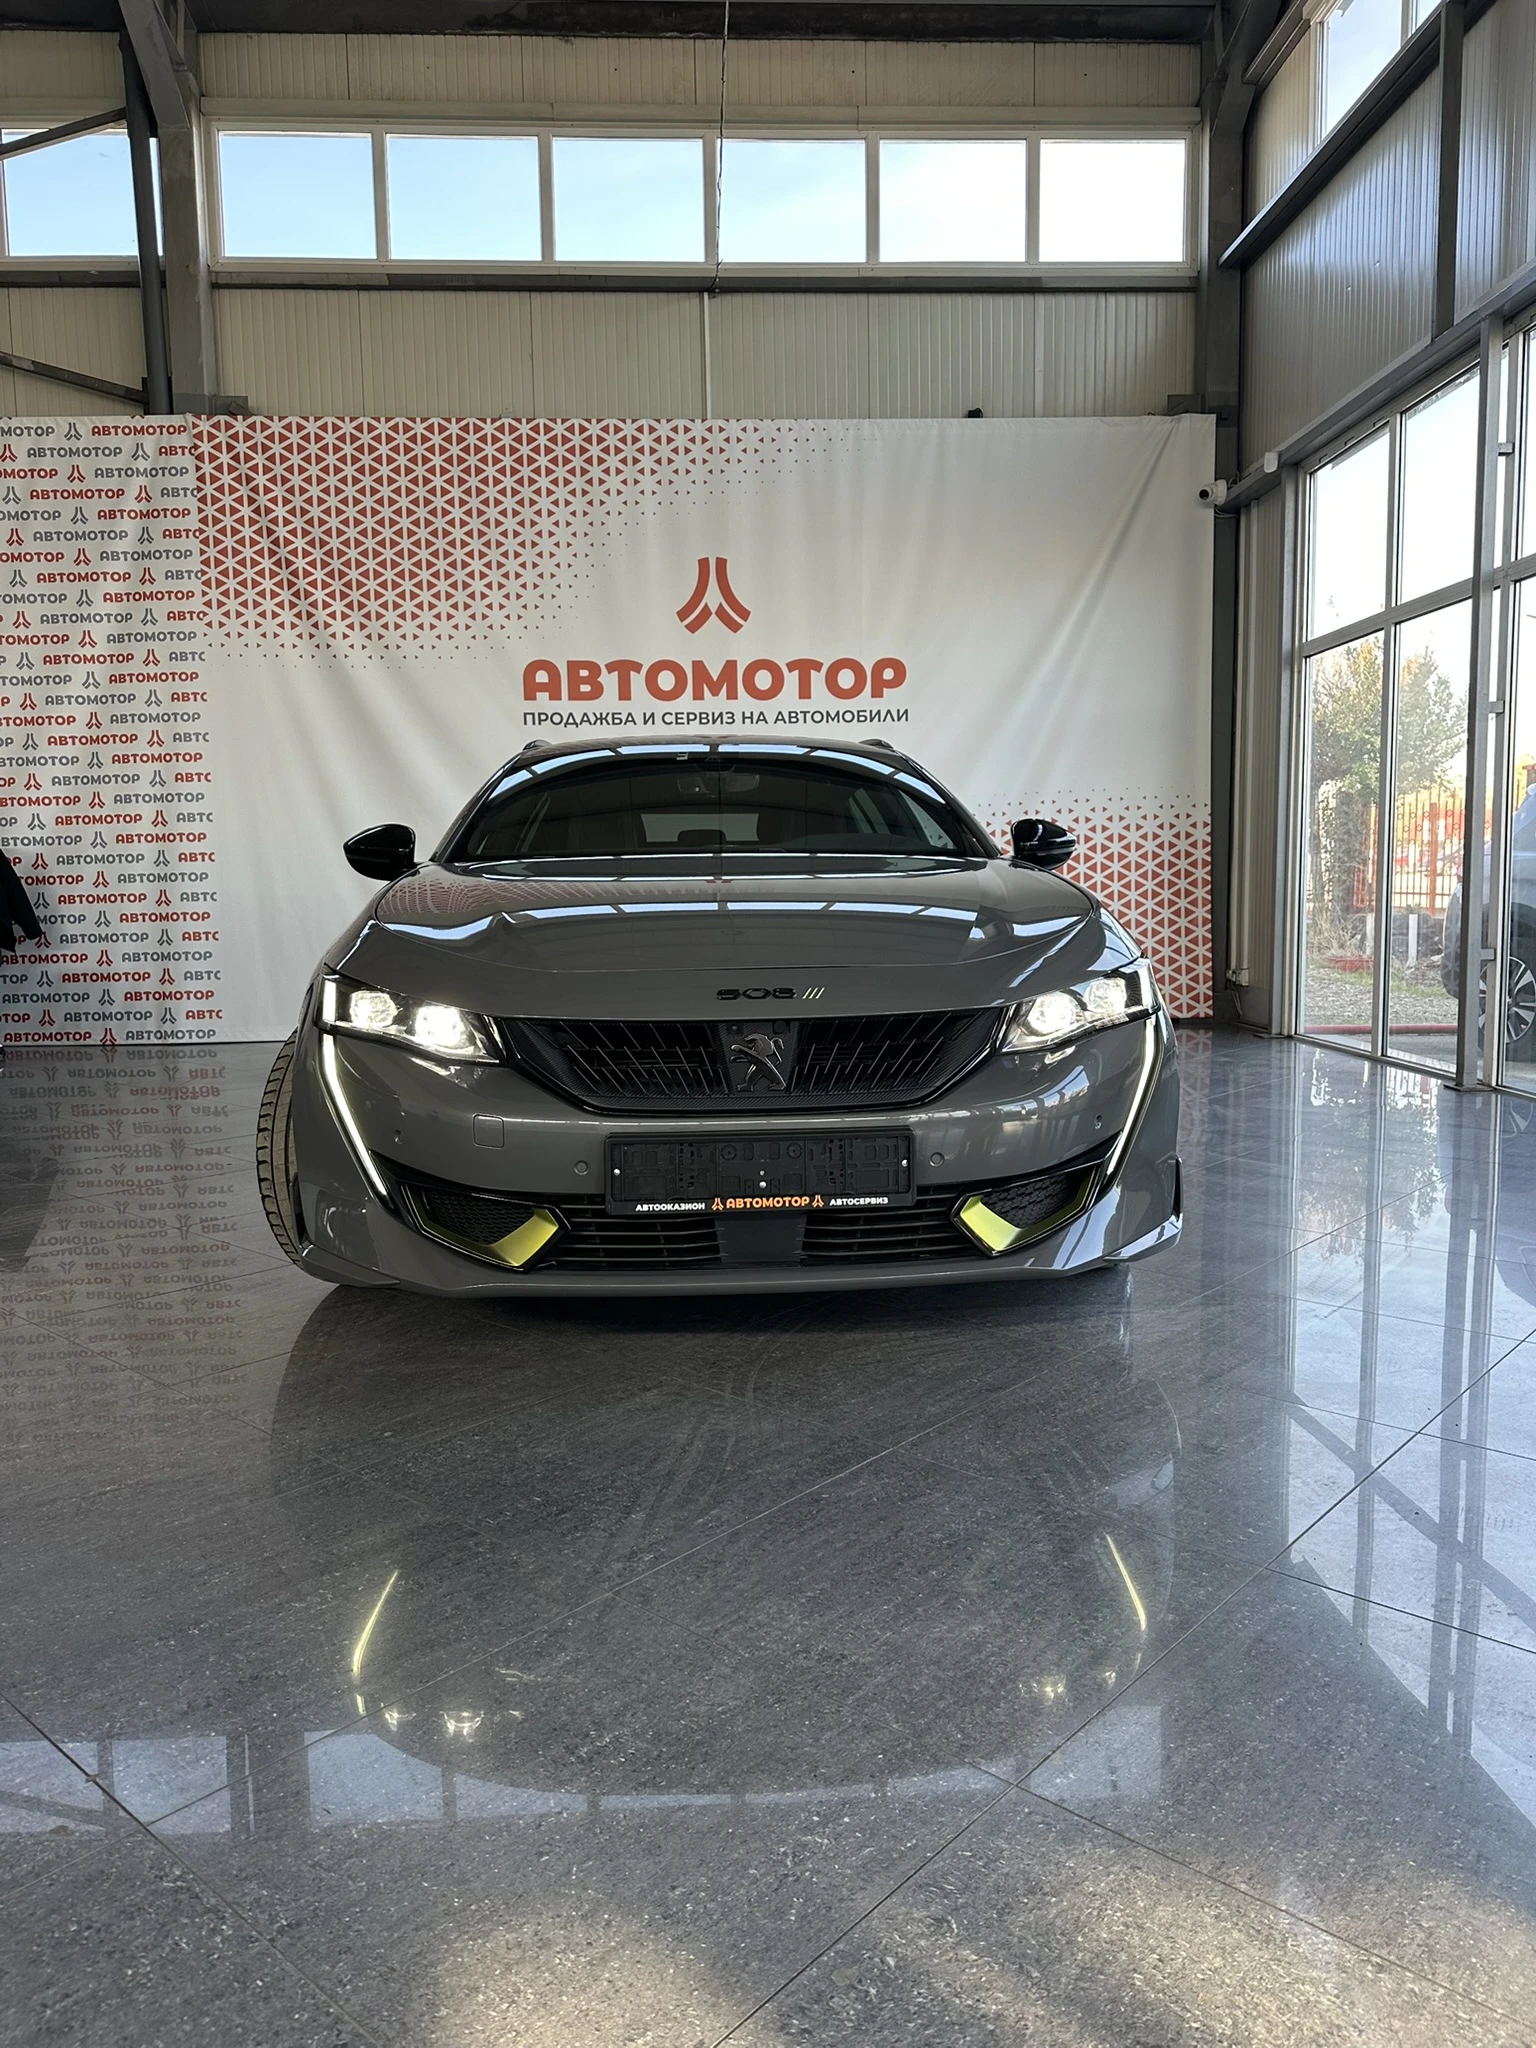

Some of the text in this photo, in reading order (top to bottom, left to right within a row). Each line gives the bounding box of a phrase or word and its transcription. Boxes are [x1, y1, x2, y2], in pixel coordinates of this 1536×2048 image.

[92, 424, 187, 436] АВТОМОТОР
[27, 447, 122, 458] АВТОМОТОР
[95, 467, 189, 478] АВТОМОТОР
[30, 488, 125, 500] АВТОМОТОР
[98, 508, 191, 520] АВТОМОТОР
[34, 530, 128, 541] АВТОМОТОР
[100, 549, 193, 561] АВТОМОТОР
[37, 571, 131, 583] АВТОМОТОР
[103, 590, 195, 602] АВТОМОТОР
[40, 613, 132, 624] АВТОМОТОР
[107, 631, 197, 644] АВТОМОТОР
[43, 653, 134, 665] АВТОМОТОР
[109, 672, 199, 684] АВТОМОТОР
[523, 657, 907, 701] АВТОМОТОР
[46, 694, 136, 705] АВТОМОТОР
[110, 712, 200, 724] АВТОМОТОР
[523, 708, 909, 728] ПРОДАЖБА И СЕРВИЗ НА АВТОМОБИЛИ
[48, 734, 138, 746] АВТОМОТОР
[112, 752, 202, 764] АВТОМОТОР
[52, 774, 140, 786] АВТОМОТОР
[114, 793, 204, 804] АВТОМОТОР
[55, 814, 142, 826] АВТОМОТОР
[116, 832, 206, 844] АВТОМОТОР
[57, 854, 144, 865] АВТОМОТОР
[118, 872, 208, 883] АВТОМОТОР
[58, 893, 147, 904] АВТОМОТОР
[120, 912, 210, 923] АВТОМОТОР
[60, 933, 149, 944] АВТОМОТОР
[122, 951, 212, 962] АВТОМОТОР
[62, 972, 151, 983] АВТОМОТОР
[2, 990, 214, 1004] АВТОМОТОР АВТОМОТОР
[717, 987, 797, 1000] 508
[64, 1011, 152, 1022] АВТОМОТОР
[4, 1029, 216, 1042] АВТОМОТОР АВТОМОТОР
[635, 1196, 889, 1212] АВТООКАЗИОН АВТОМОТОР АВТОСЕРВИЗ
